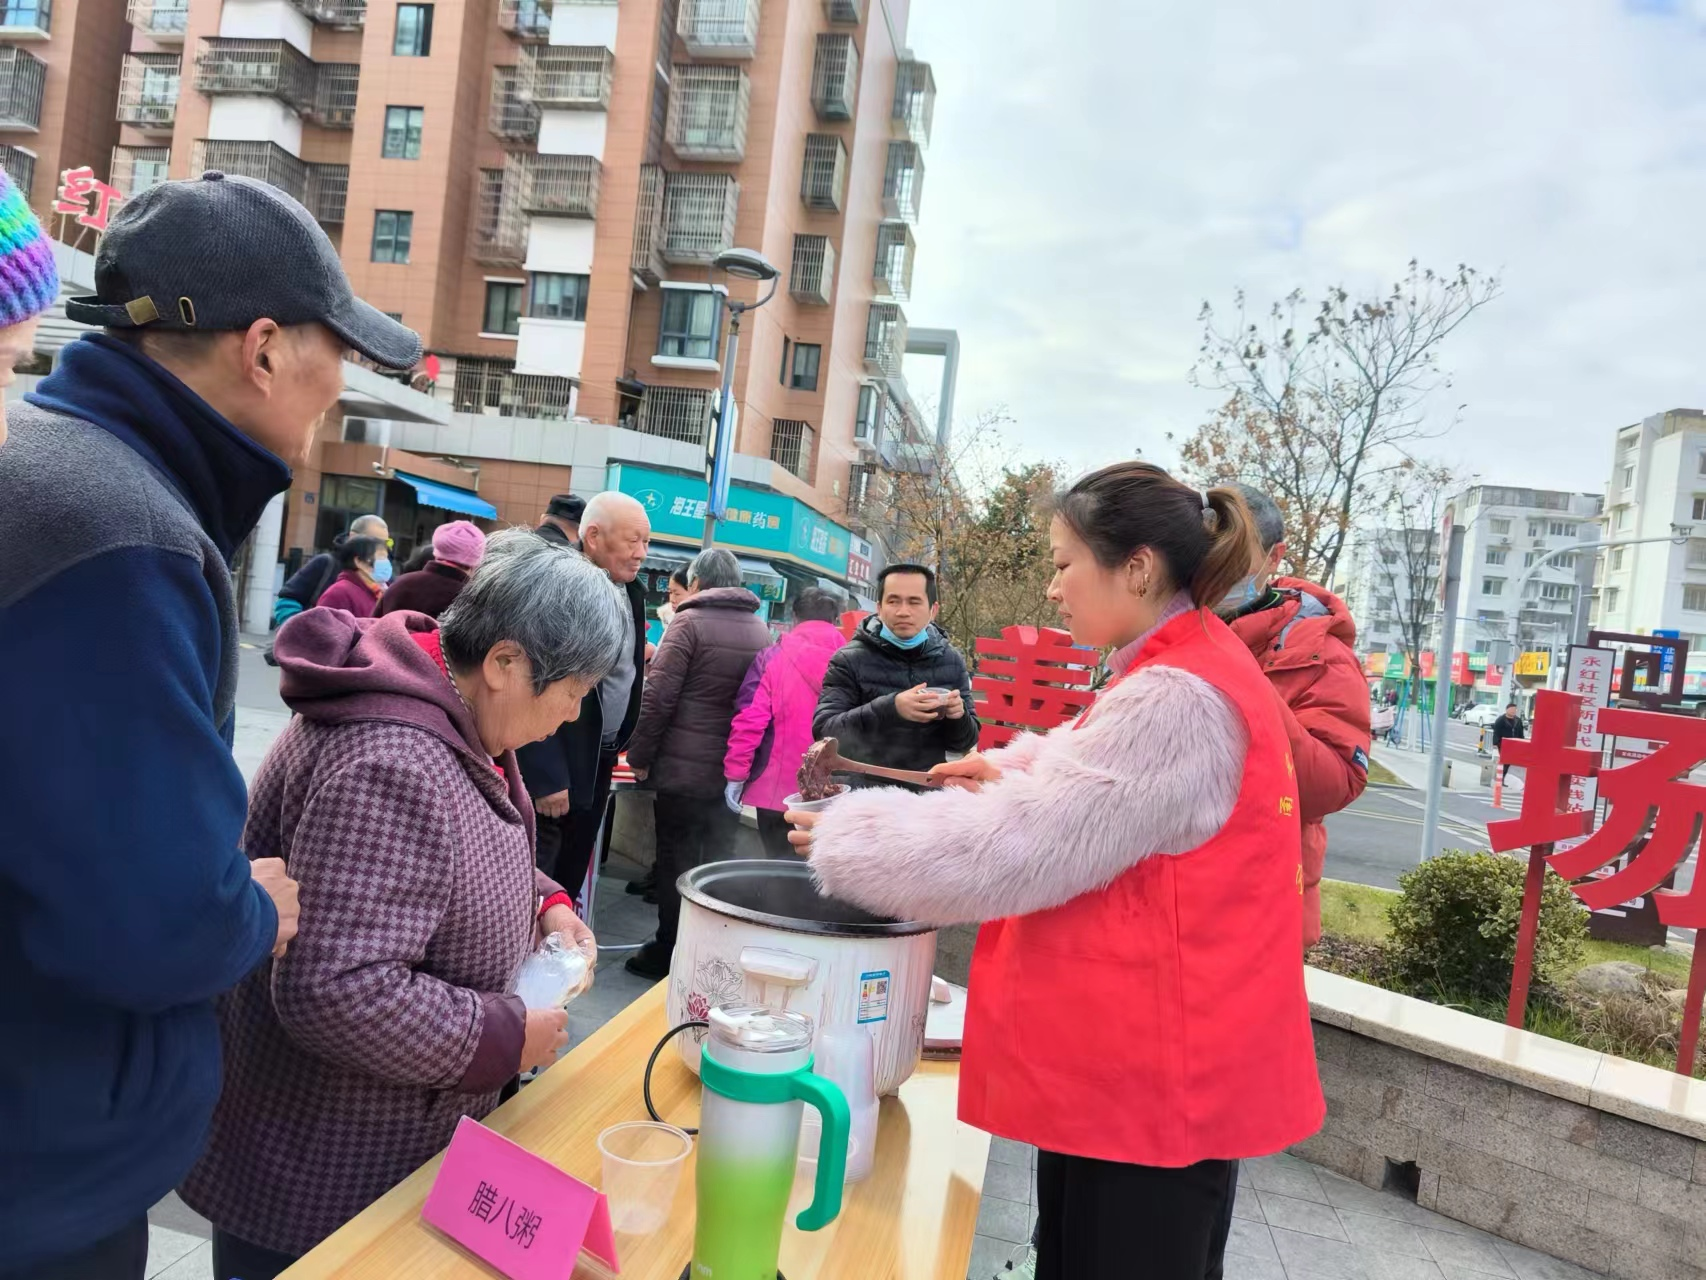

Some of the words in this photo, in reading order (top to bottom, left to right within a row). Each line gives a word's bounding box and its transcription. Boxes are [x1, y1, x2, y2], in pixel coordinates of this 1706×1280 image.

[669, 496, 780, 530] 海王星健康药房
[467, 1180, 542, 1250] 腊八粥
